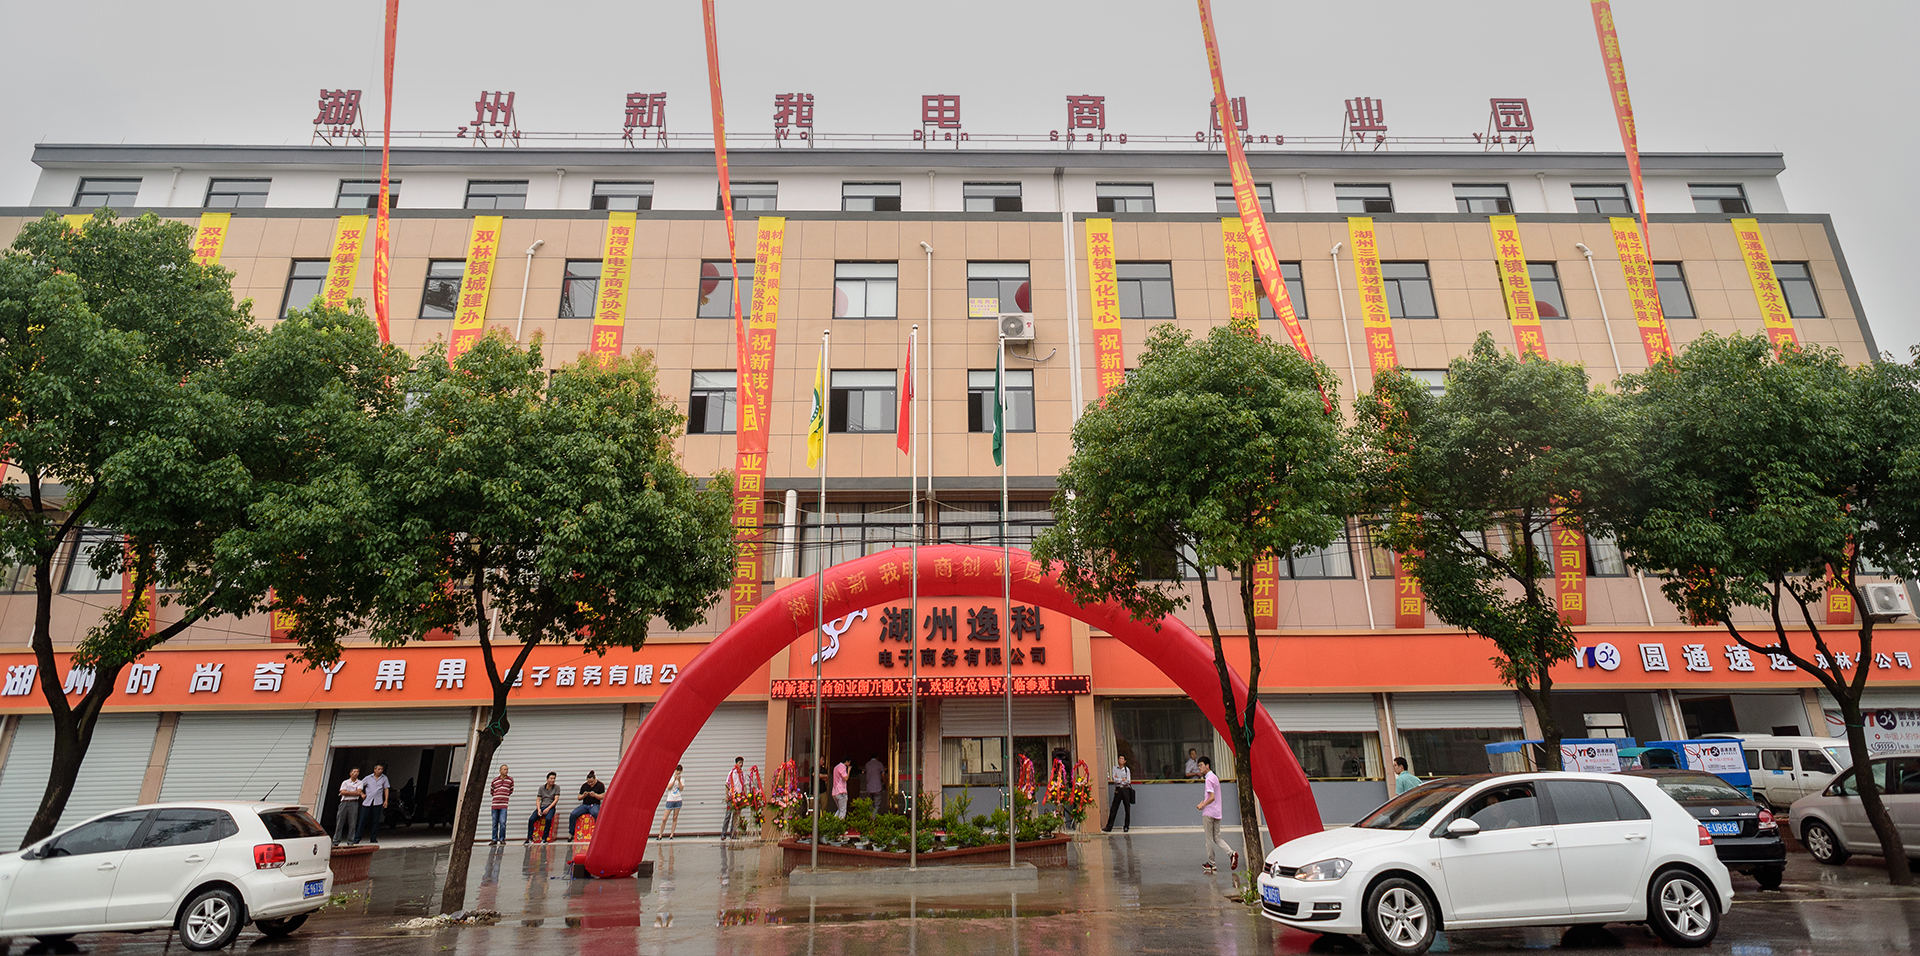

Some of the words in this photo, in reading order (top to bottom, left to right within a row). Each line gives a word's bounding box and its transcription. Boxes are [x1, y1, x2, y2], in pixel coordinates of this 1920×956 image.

[1196, 131, 1284, 145] Chang
[460, 229, 496, 325] 双林镇城建办
[599, 225, 631, 320] 南浔区电子商务协会
[751, 229, 771, 324] 湖州南浔兴发防水
[765, 229, 784, 324] 材料有限公司
[1090, 232, 1119, 324] 双林镇文化中心
[1354, 230, 1386, 323] 湖州三桥建材有限公司
[1497, 229, 1535, 321] 双林镇电信局
[1614, 230, 1650, 322] 湖州时尚奇丫果果
[1740, 231, 1787, 324] 圆通快递双林分公司
[878, 647, 1046, 667] 电子商务有限公司
[879, 605, 1045, 642] 湖州逸科
[1814, 651, 1912, 670] 双林公司
